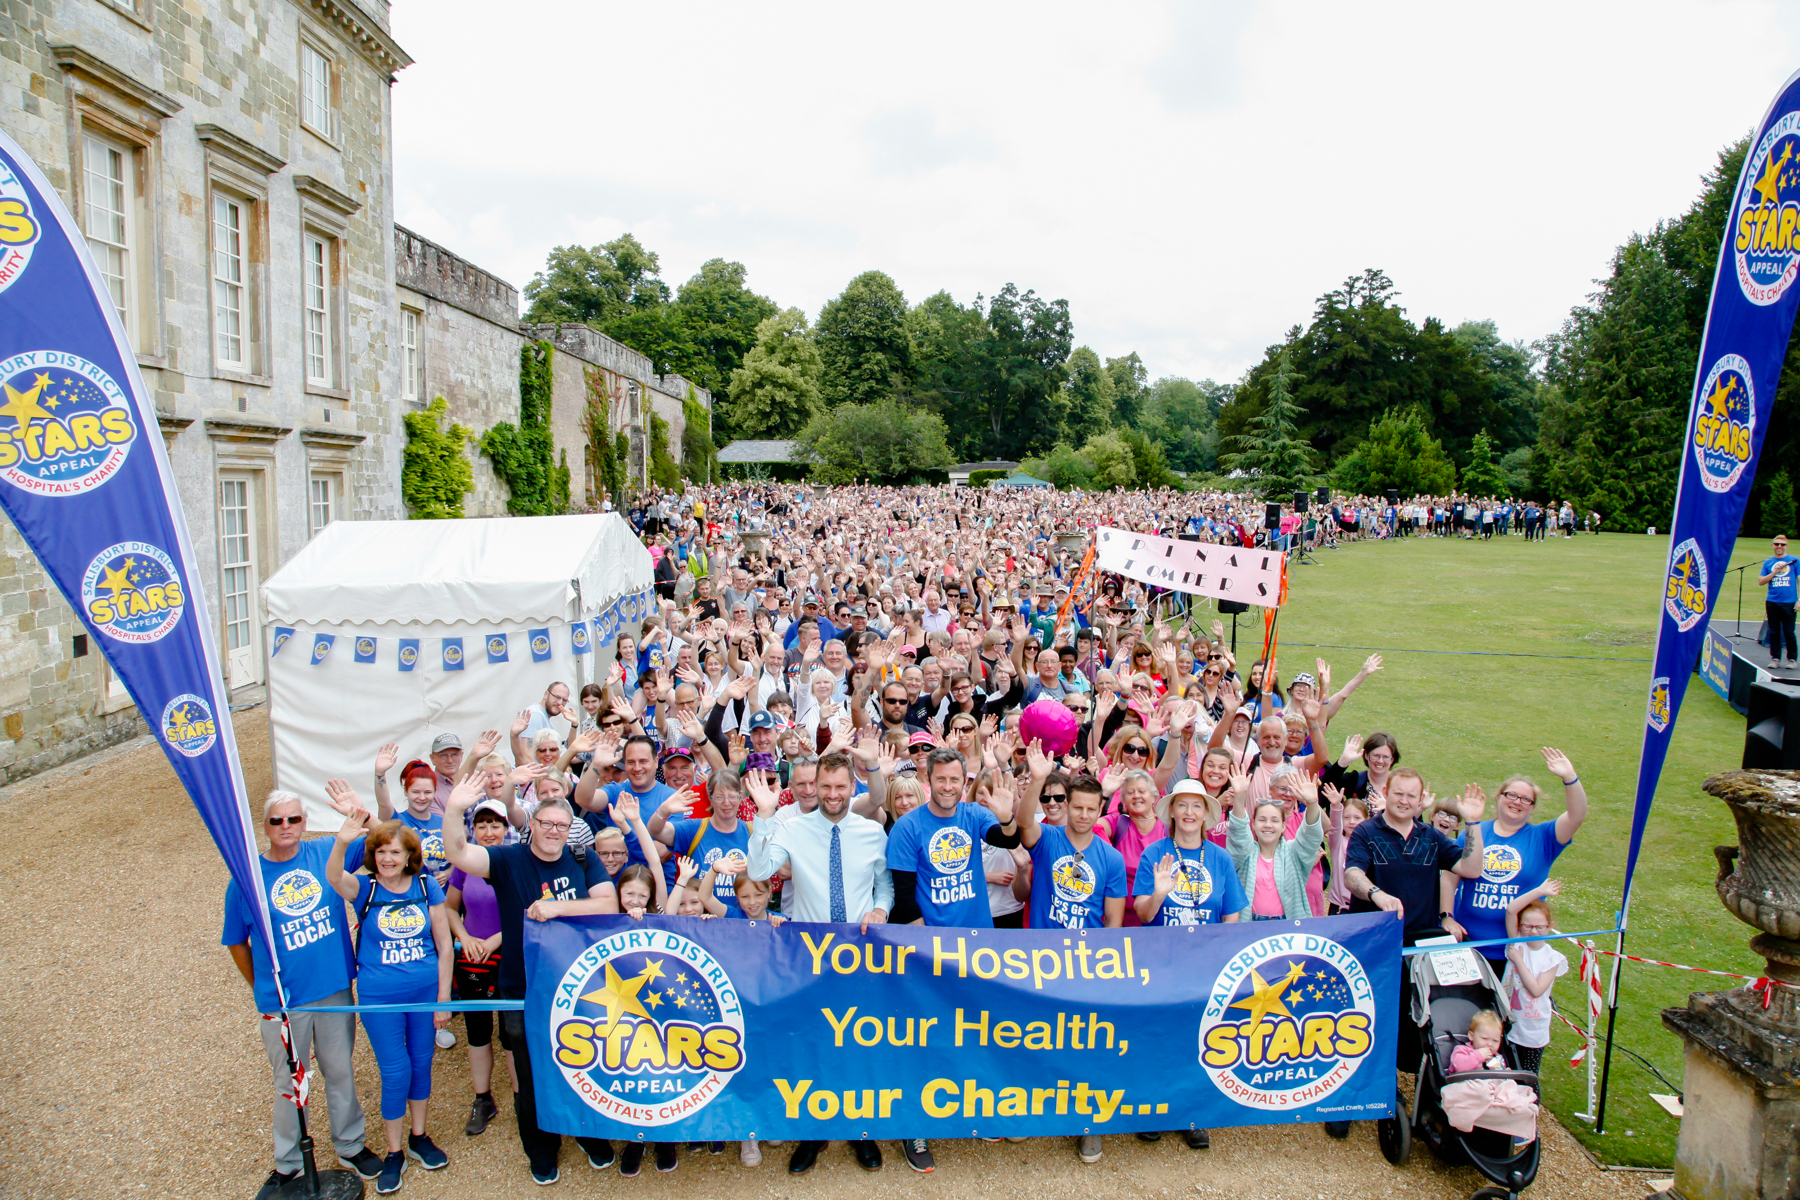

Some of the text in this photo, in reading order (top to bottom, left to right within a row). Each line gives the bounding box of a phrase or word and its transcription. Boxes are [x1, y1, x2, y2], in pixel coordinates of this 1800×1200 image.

[1743, 113, 1795, 199] SALISBURY
[0, 250, 24, 284] RITY
[1738, 256, 1765, 300] HOSPITAL'S
[1750, 262, 1783, 275] APPEAL
[45, 352, 123, 399] DISTRICT
[1700, 355, 1736, 406] SALISBURY
[0, 409, 133, 466] STARS
[6, 448, 124, 493] HOSPITAL'S CHARITY
[39, 456, 99, 477] APPEAL
[1100, 531, 1272, 572] SPINAL
[83, 542, 177, 596] SALISBURY DISTRICT
[90, 583, 183, 624] STARS
[1667, 576, 1706, 613] STRS
[105, 610, 179, 641] HOSPITAL'S CHARITY
[126, 616, 163, 630] APPEAL
[166, 719, 216, 742] STARS
[422, 849, 446, 859] STA
[931, 844, 972, 863] STARS
[1483, 861, 1520, 870] TARS
[553, 876, 570, 891] I'D
[930, 870, 973, 888] LET'S GET
[1053, 871, 1093, 894] STARS
[1080, 861, 1095, 882] ISTRICT
[275, 883, 321, 907] STARS
[556, 887, 577, 901] HIT
[931, 882, 976, 904] LOCAL
[1474, 882, 1520, 895] LET'S GET
[280, 905, 331, 935] LET'S GET
[380, 915, 425, 928] STARS
[1071, 904, 1090, 917] GET
[284, 918, 335, 951] LOCAL
[379, 938, 424, 950] LET'S GET
[382, 945, 427, 964] LOCAL
[799, 931, 1150, 990] Your Hospital,
[556, 931, 741, 1017] SALISBURY DISTRICT
[1206, 935, 1372, 1018] SALISBURY DISTRICT
[557, 1022, 740, 1071] STARS
[820, 1006, 1129, 1057] Your Health,
[1204, 1014, 1371, 1067] STARS
[609, 1079, 687, 1094] APPEAL
[1216, 1061, 1350, 1105] HOSPITAL'S CHARITY
[1250, 1066, 1318, 1085] APPEAL
[571, 1071, 722, 1121] HOSPITAL'S CHARITY
[772, 1077, 1169, 1124] Your Charity...
[1316, 1105, 1345, 1113] Registered
